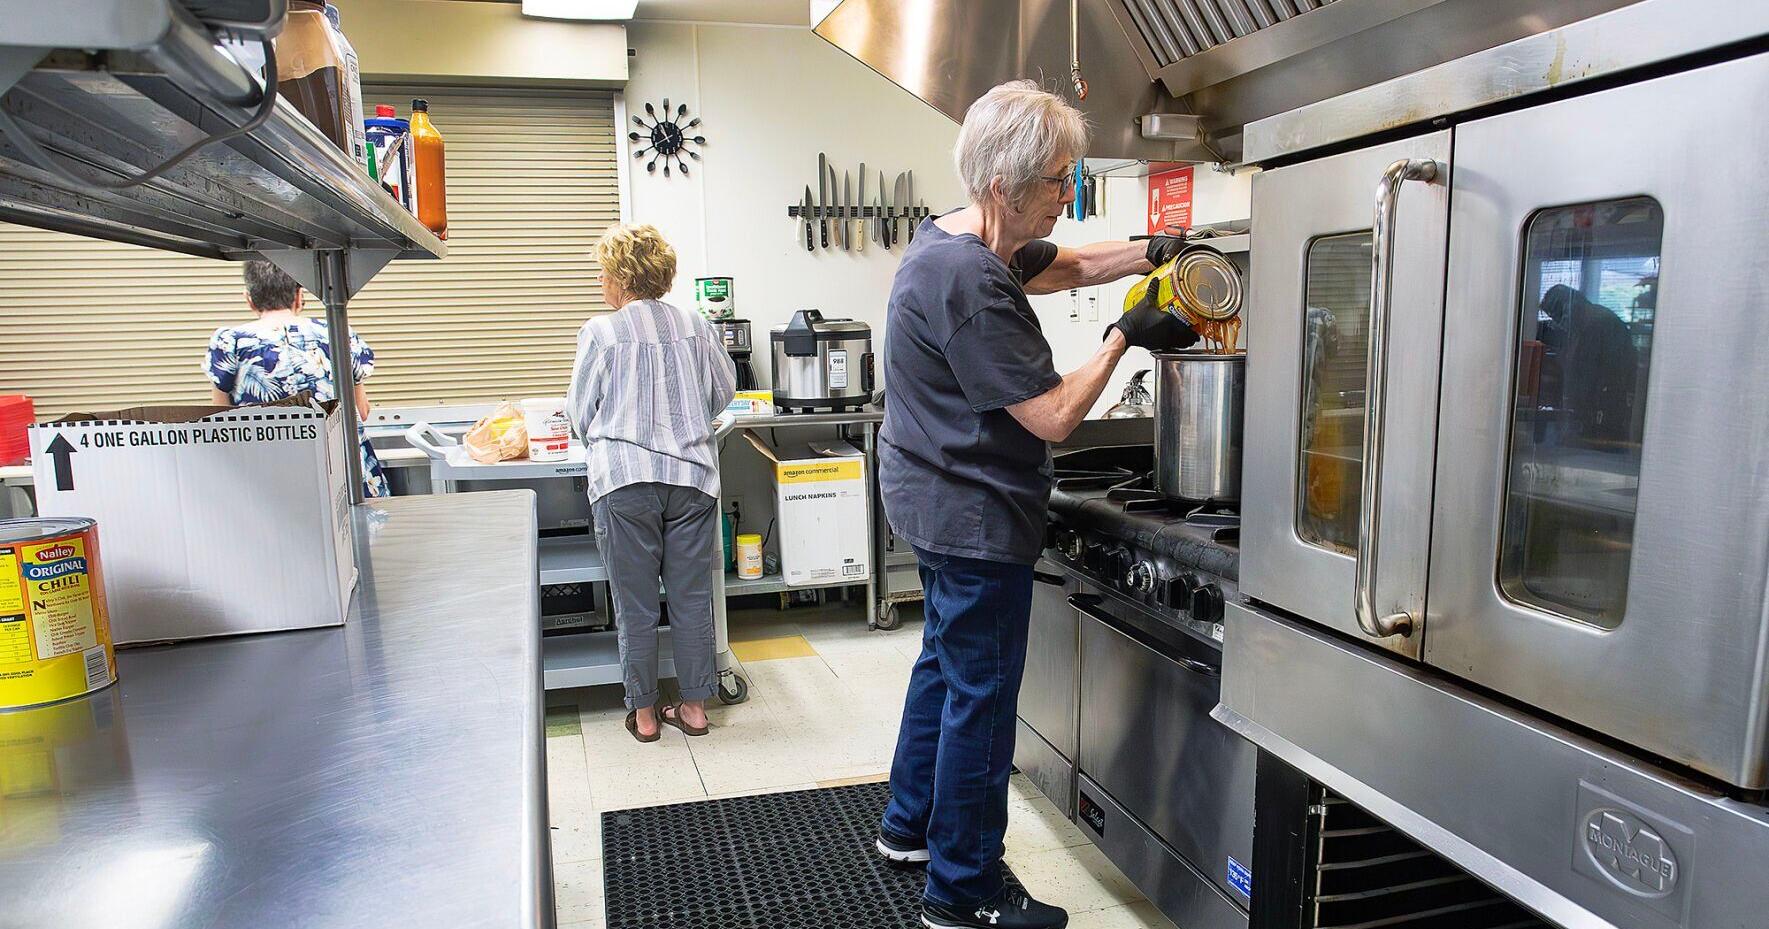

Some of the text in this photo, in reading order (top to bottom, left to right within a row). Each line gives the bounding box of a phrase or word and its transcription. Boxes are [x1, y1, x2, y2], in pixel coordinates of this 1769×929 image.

[80, 424, 317, 448] 4 ONE GALLON PLASTIC BOTTLES
[784, 466, 839, 478] amazon commercial
[808, 492, 837, 500] NAPKINS
[40, 546, 74, 560] Nalley
[29, 560, 84, 578] ORIGINAL
[38, 575, 80, 592] CHILI
